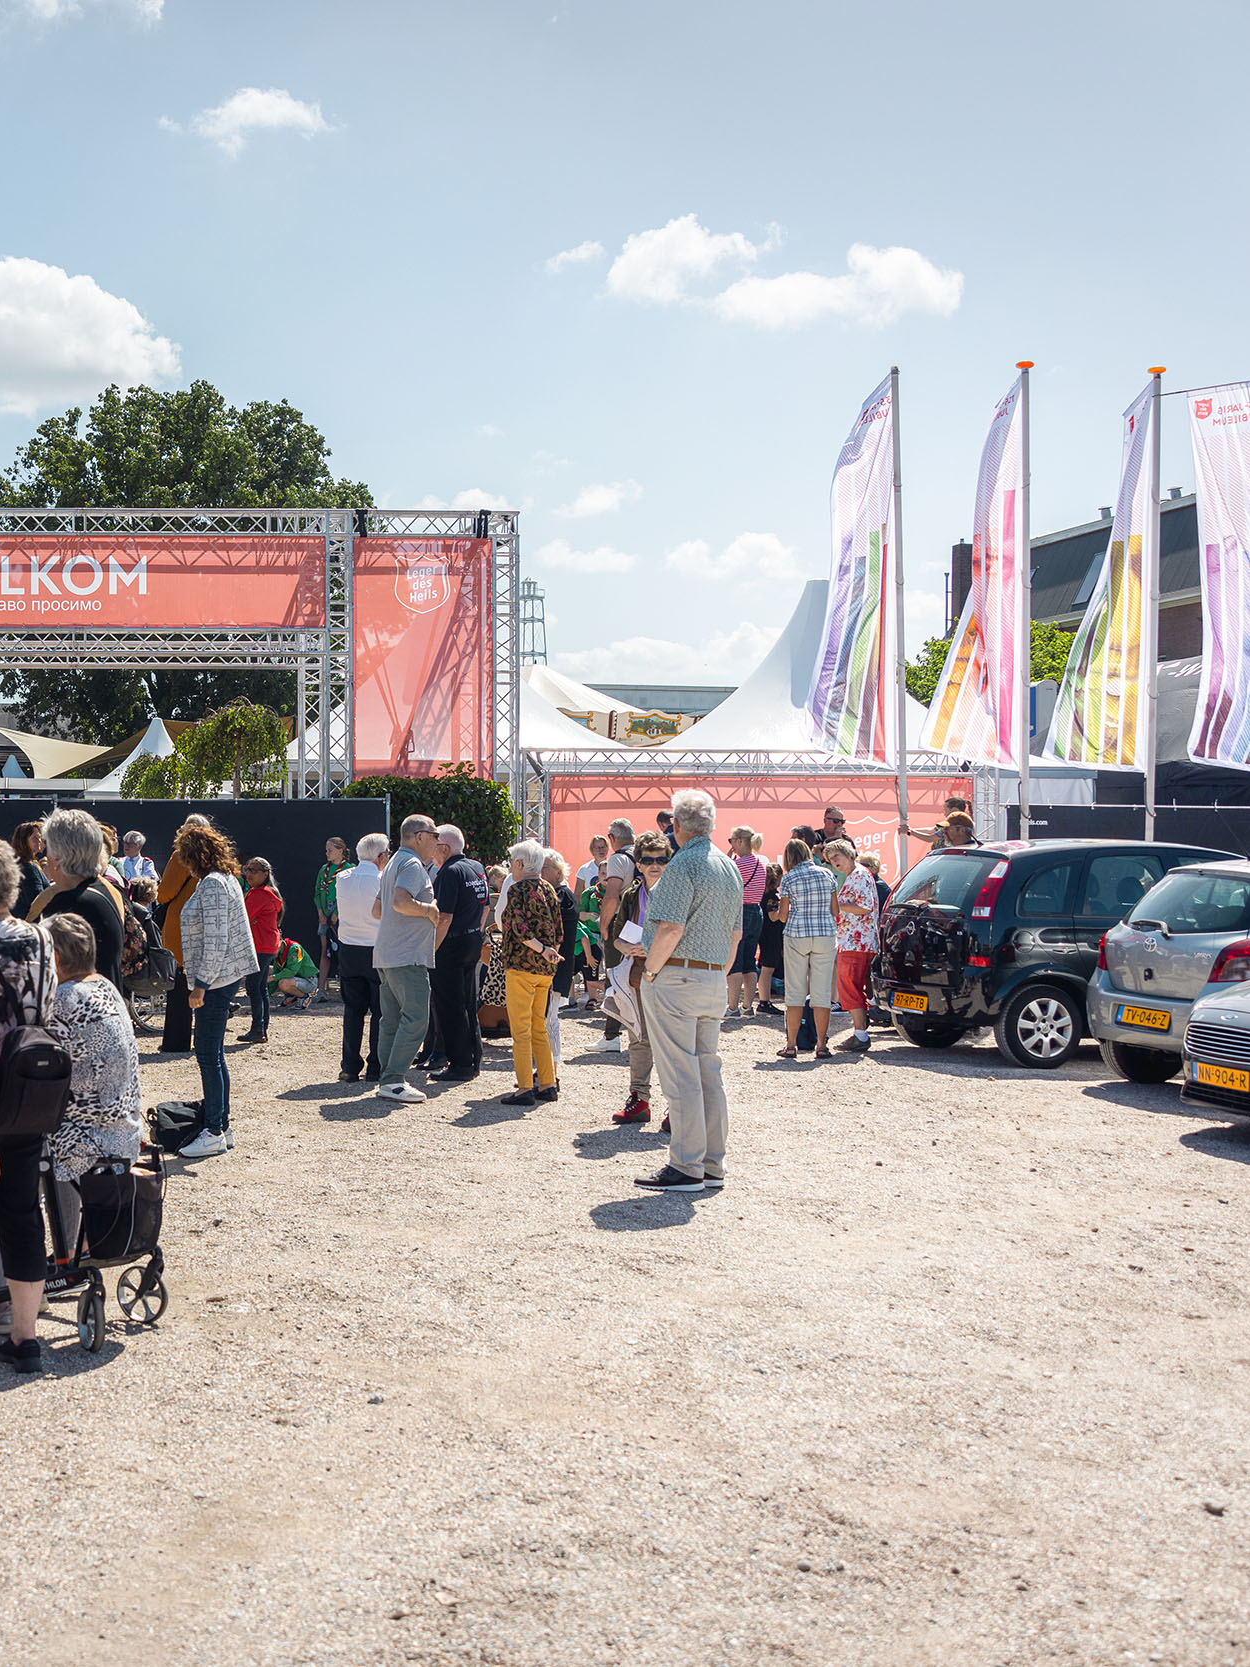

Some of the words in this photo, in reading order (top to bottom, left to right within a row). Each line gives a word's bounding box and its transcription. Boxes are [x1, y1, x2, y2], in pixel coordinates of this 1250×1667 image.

[407, 566, 439, 580] Leger
[412, 578, 432, 591] des
[409, 588, 438, 603] Heils
[31, 600, 102, 615] просимо
[853, 830, 889, 849] eger
[1125, 1008, 1167, 1027] TV-046-Z
[1198, 1065, 1247, 1089] NN-904-R
